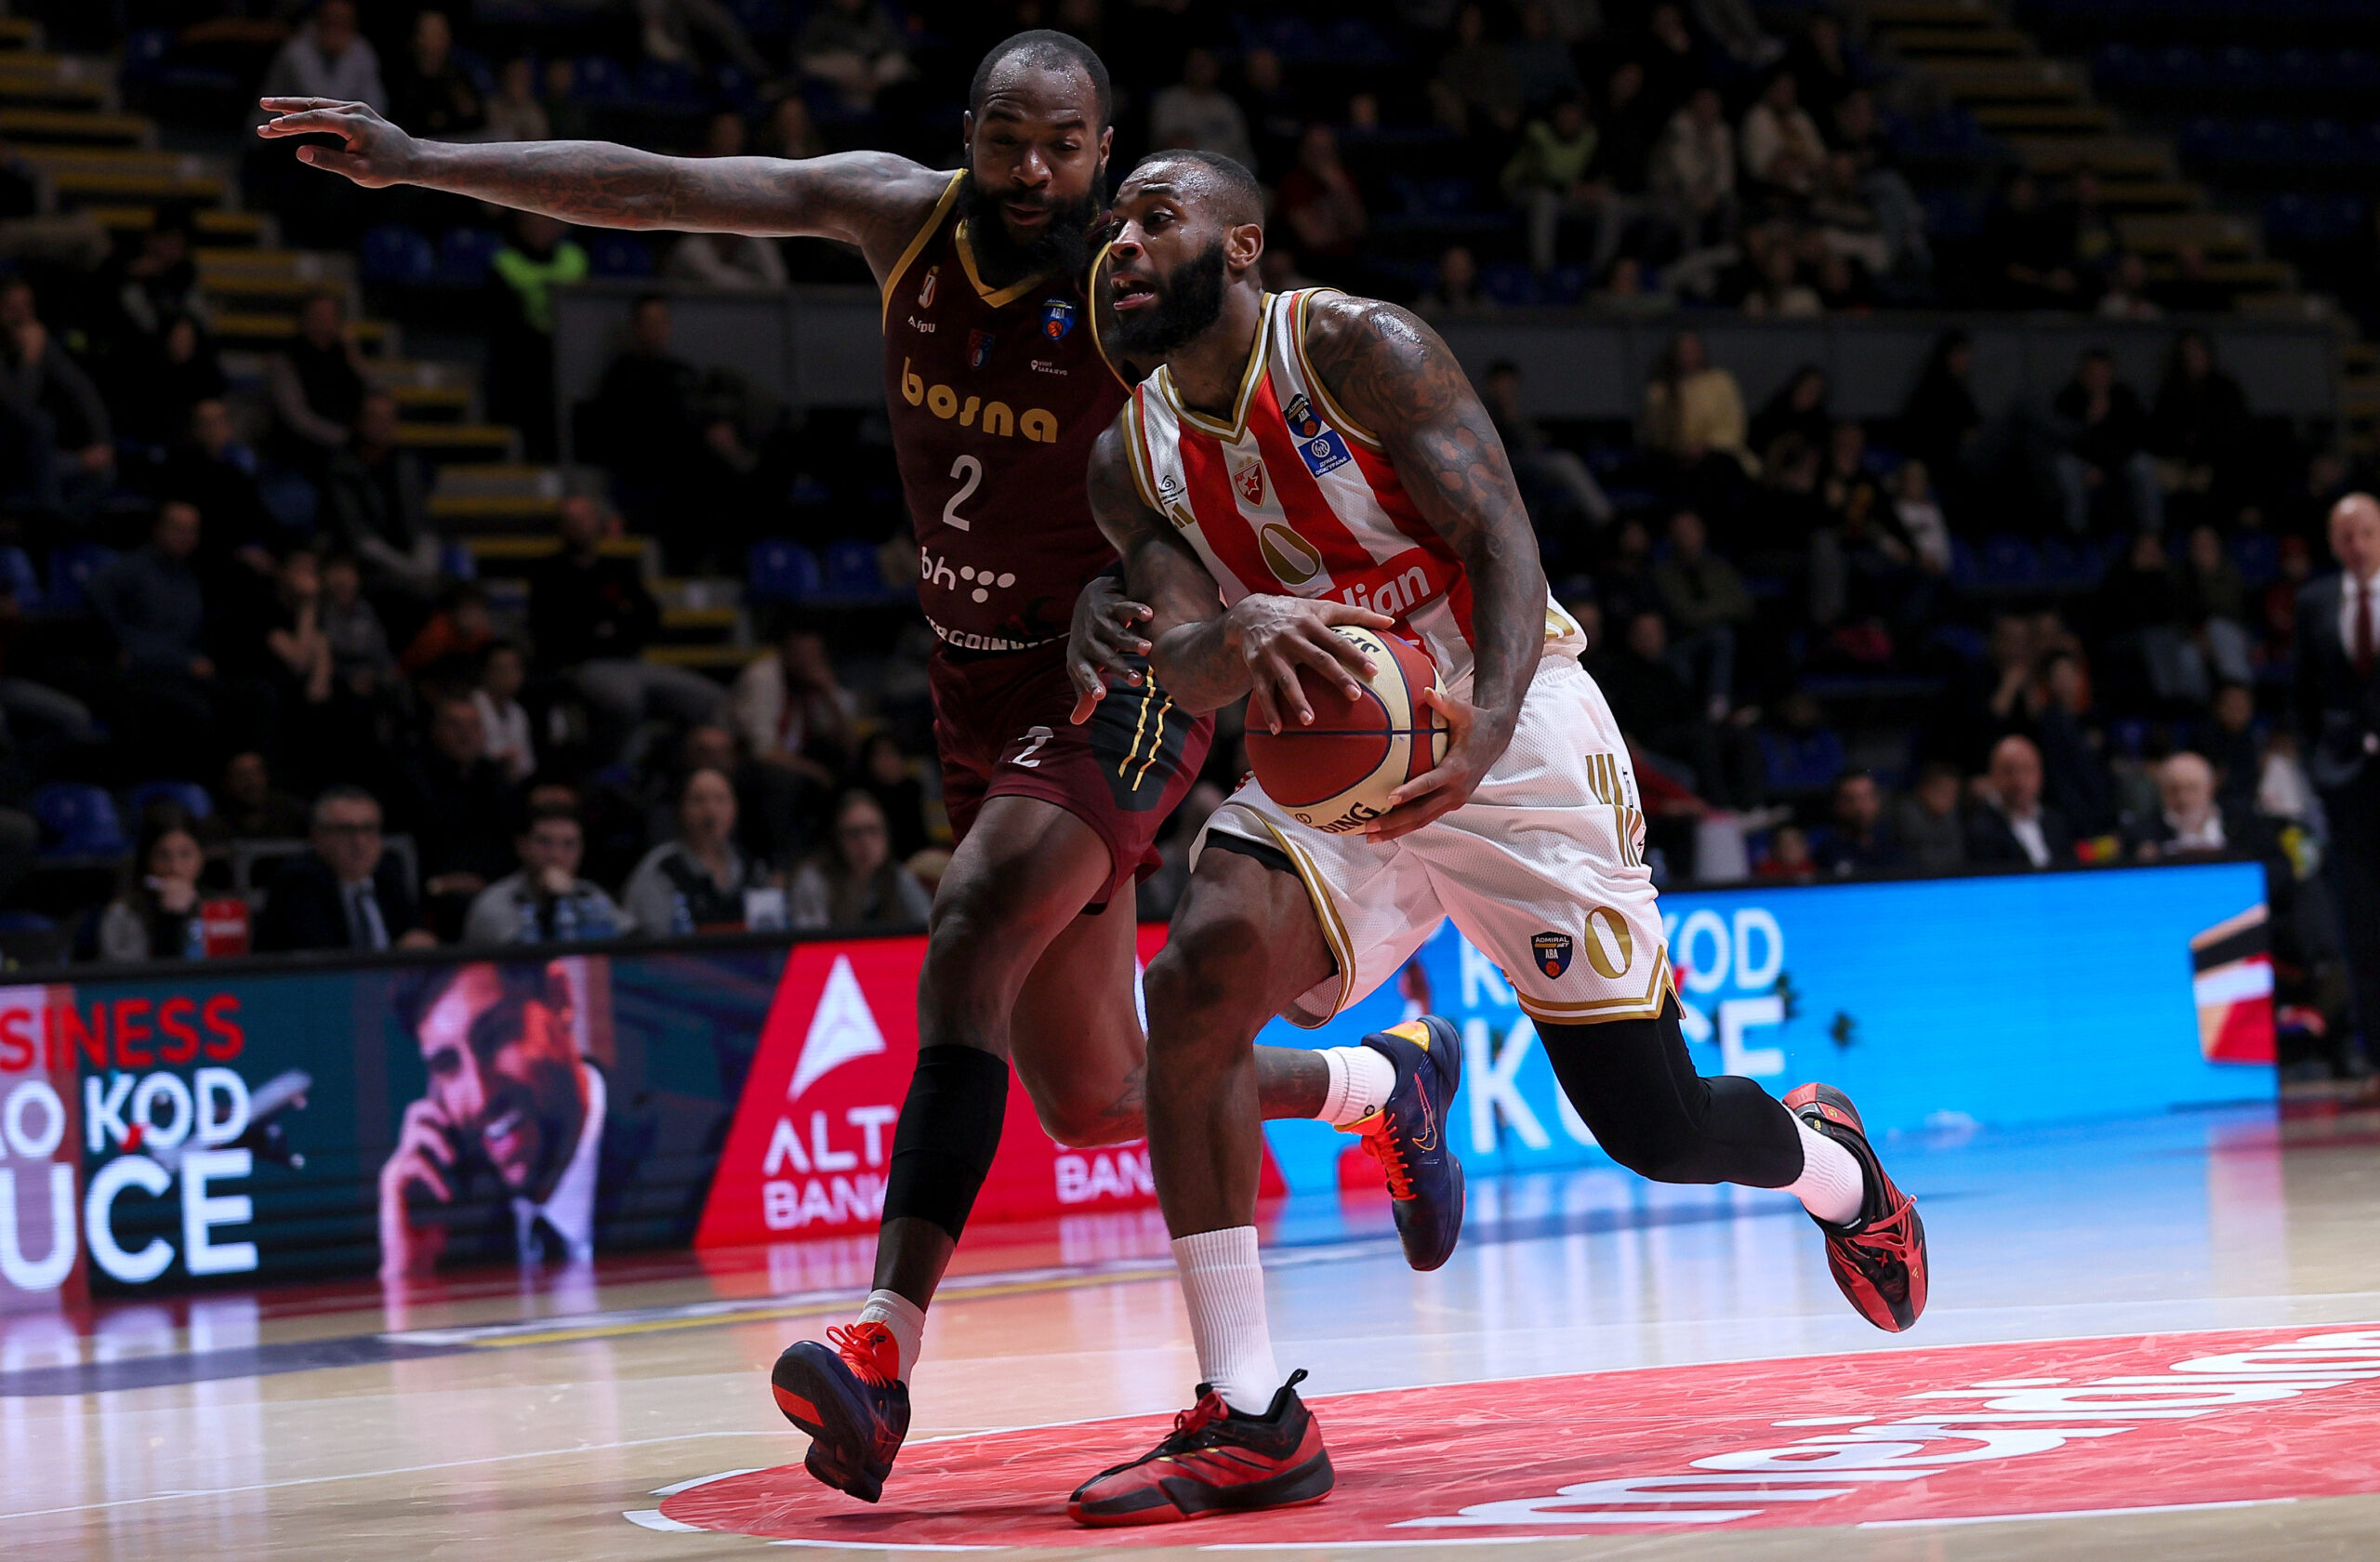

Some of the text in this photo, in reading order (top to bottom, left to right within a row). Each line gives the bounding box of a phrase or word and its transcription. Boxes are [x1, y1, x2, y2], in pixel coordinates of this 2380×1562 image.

[901, 357, 1059, 443] bosna
[942, 454, 983, 531] 2
[1259, 523, 1322, 586] 0
[1008, 725, 1053, 767] 2
[1545, 948, 1559, 960] ABA
[1584, 906, 1633, 979] 0
[85, 1066, 252, 1155] KOD
